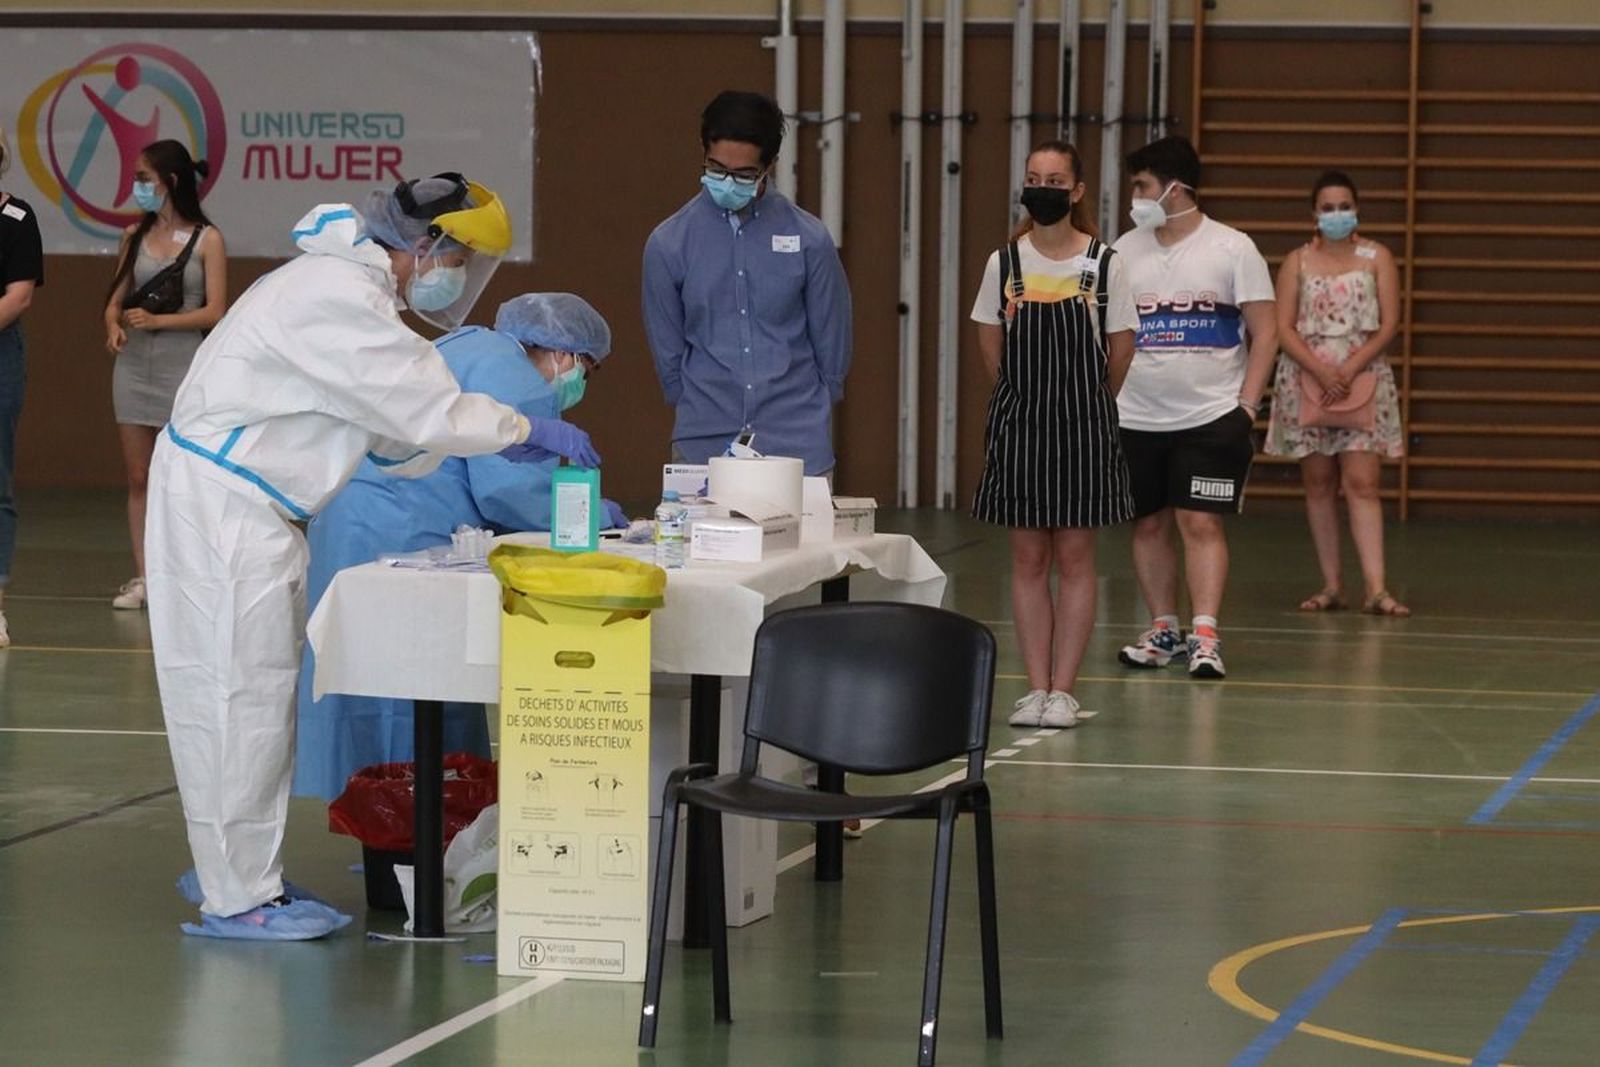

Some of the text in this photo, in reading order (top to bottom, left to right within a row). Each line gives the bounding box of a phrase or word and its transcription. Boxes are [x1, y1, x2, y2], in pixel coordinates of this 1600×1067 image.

[241, 112, 404, 139] UNIVERSO
[242, 144, 404, 181] MUJER
[1169, 319, 1216, 329] SPORT
[1191, 480, 1234, 497] PUMA
[519, 697, 564, 711] DECHETS
[506, 714, 643, 732] DE SOINS SOLIDES ET MOUS
[529, 734, 571, 748] RISQUES
[573, 736, 632, 750] INFECTIEUX
